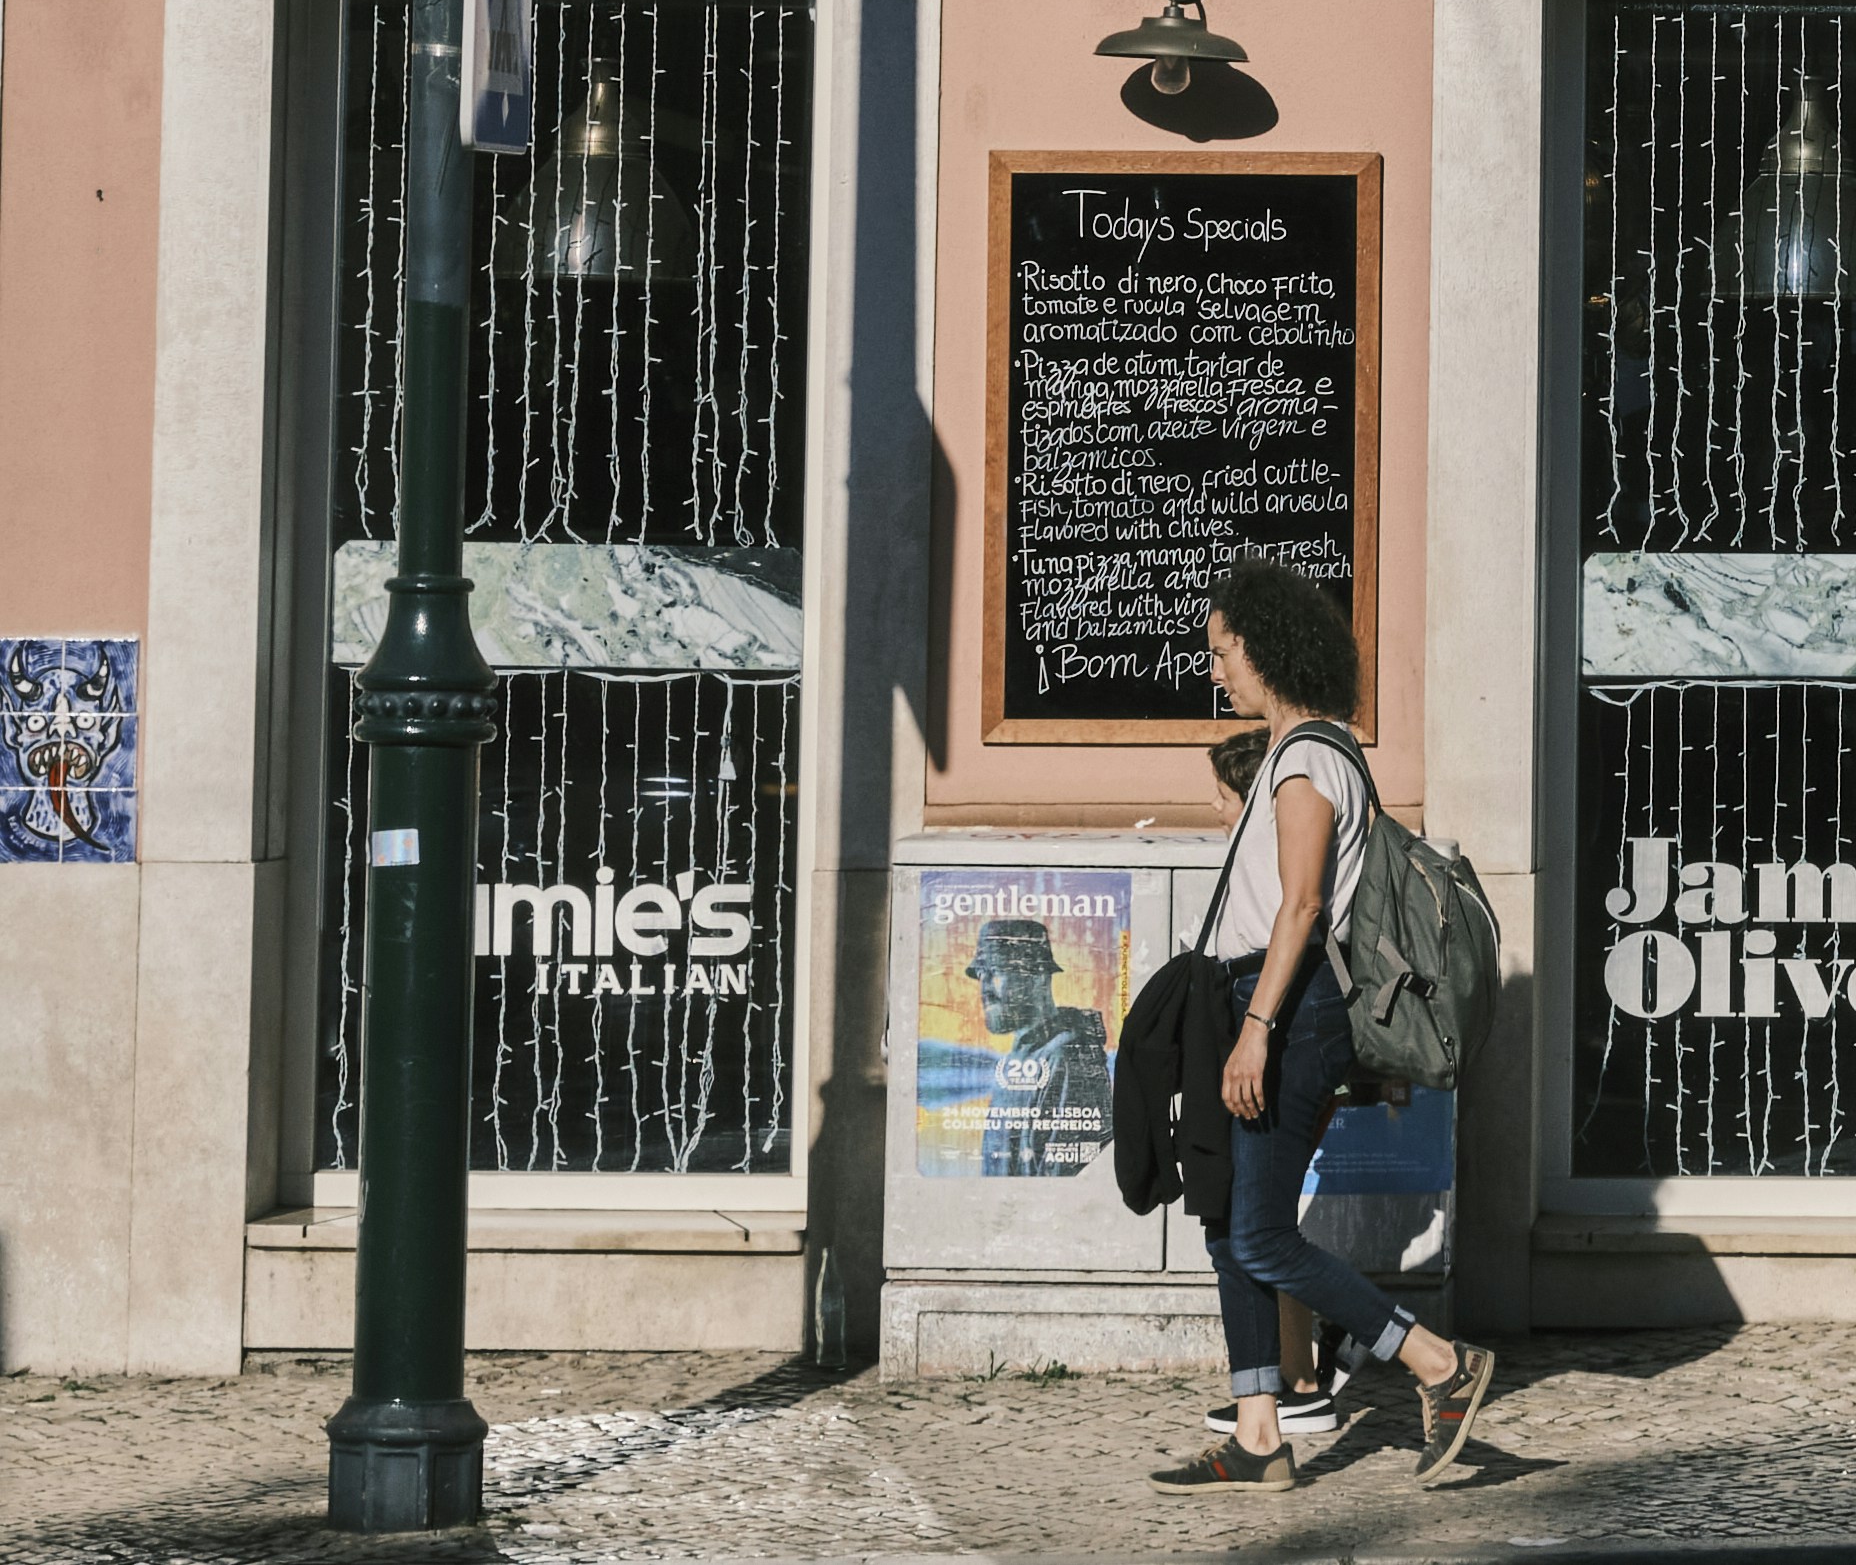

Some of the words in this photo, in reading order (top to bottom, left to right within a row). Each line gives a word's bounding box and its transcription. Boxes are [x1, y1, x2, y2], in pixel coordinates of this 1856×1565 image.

[1061, 189, 1175, 264] Today's
[1183, 207, 1287, 253] Specials
[1020, 260, 1106, 292] Risotto
[1117, 265, 1140, 294] di
[1021, 292, 1099, 316] tomate
[1102, 296, 1118, 315] e
[1123, 295, 1185, 317] rucula
[1023, 316, 1178, 344] aromatizado
[1189, 324, 1242, 344] com
[1248, 319, 1355, 349] cebolinho
[1019, 348, 1089, 388] Pizza
[1092, 351, 1121, 376] de
[1183, 348, 1255, 379] tartar
[1256, 350, 1285, 379] de
[1314, 376, 1335, 395] e
[1095, 423, 1145, 444] com
[1147, 415, 1217, 441] azeite
[1311, 418, 1328, 436] e
[1021, 471, 1107, 497] Risotto
[1110, 468, 1135, 497] di
[1071, 495, 1155, 519] tomato
[1211, 489, 1260, 515] wild
[1265, 485, 1348, 514] arugula
[1115, 517, 1163, 541] with
[1017, 548, 1073, 576] Tuna
[1136, 546, 1206, 578] mango
[1163, 562, 1212, 590] and
[1118, 592, 1173, 618] with
[1173, 591, 1211, 628] virg
[1025, 616, 1070, 642] and
[475, 865, 752, 957] mie's
[933, 884, 1117, 925] gentleman
[536, 963, 748, 996] ITALIAN
[1007, 1058, 1039, 1078] 20
[942, 1119, 1002, 1131] COLISEU
[1032, 1119, 1102, 1132] RECREIOS
[960, 1107, 1042, 1119] NOVEMBRO
[1052, 1107, 1102, 1120] LISBOA
[1044, 1152, 1079, 1164] AQUI
